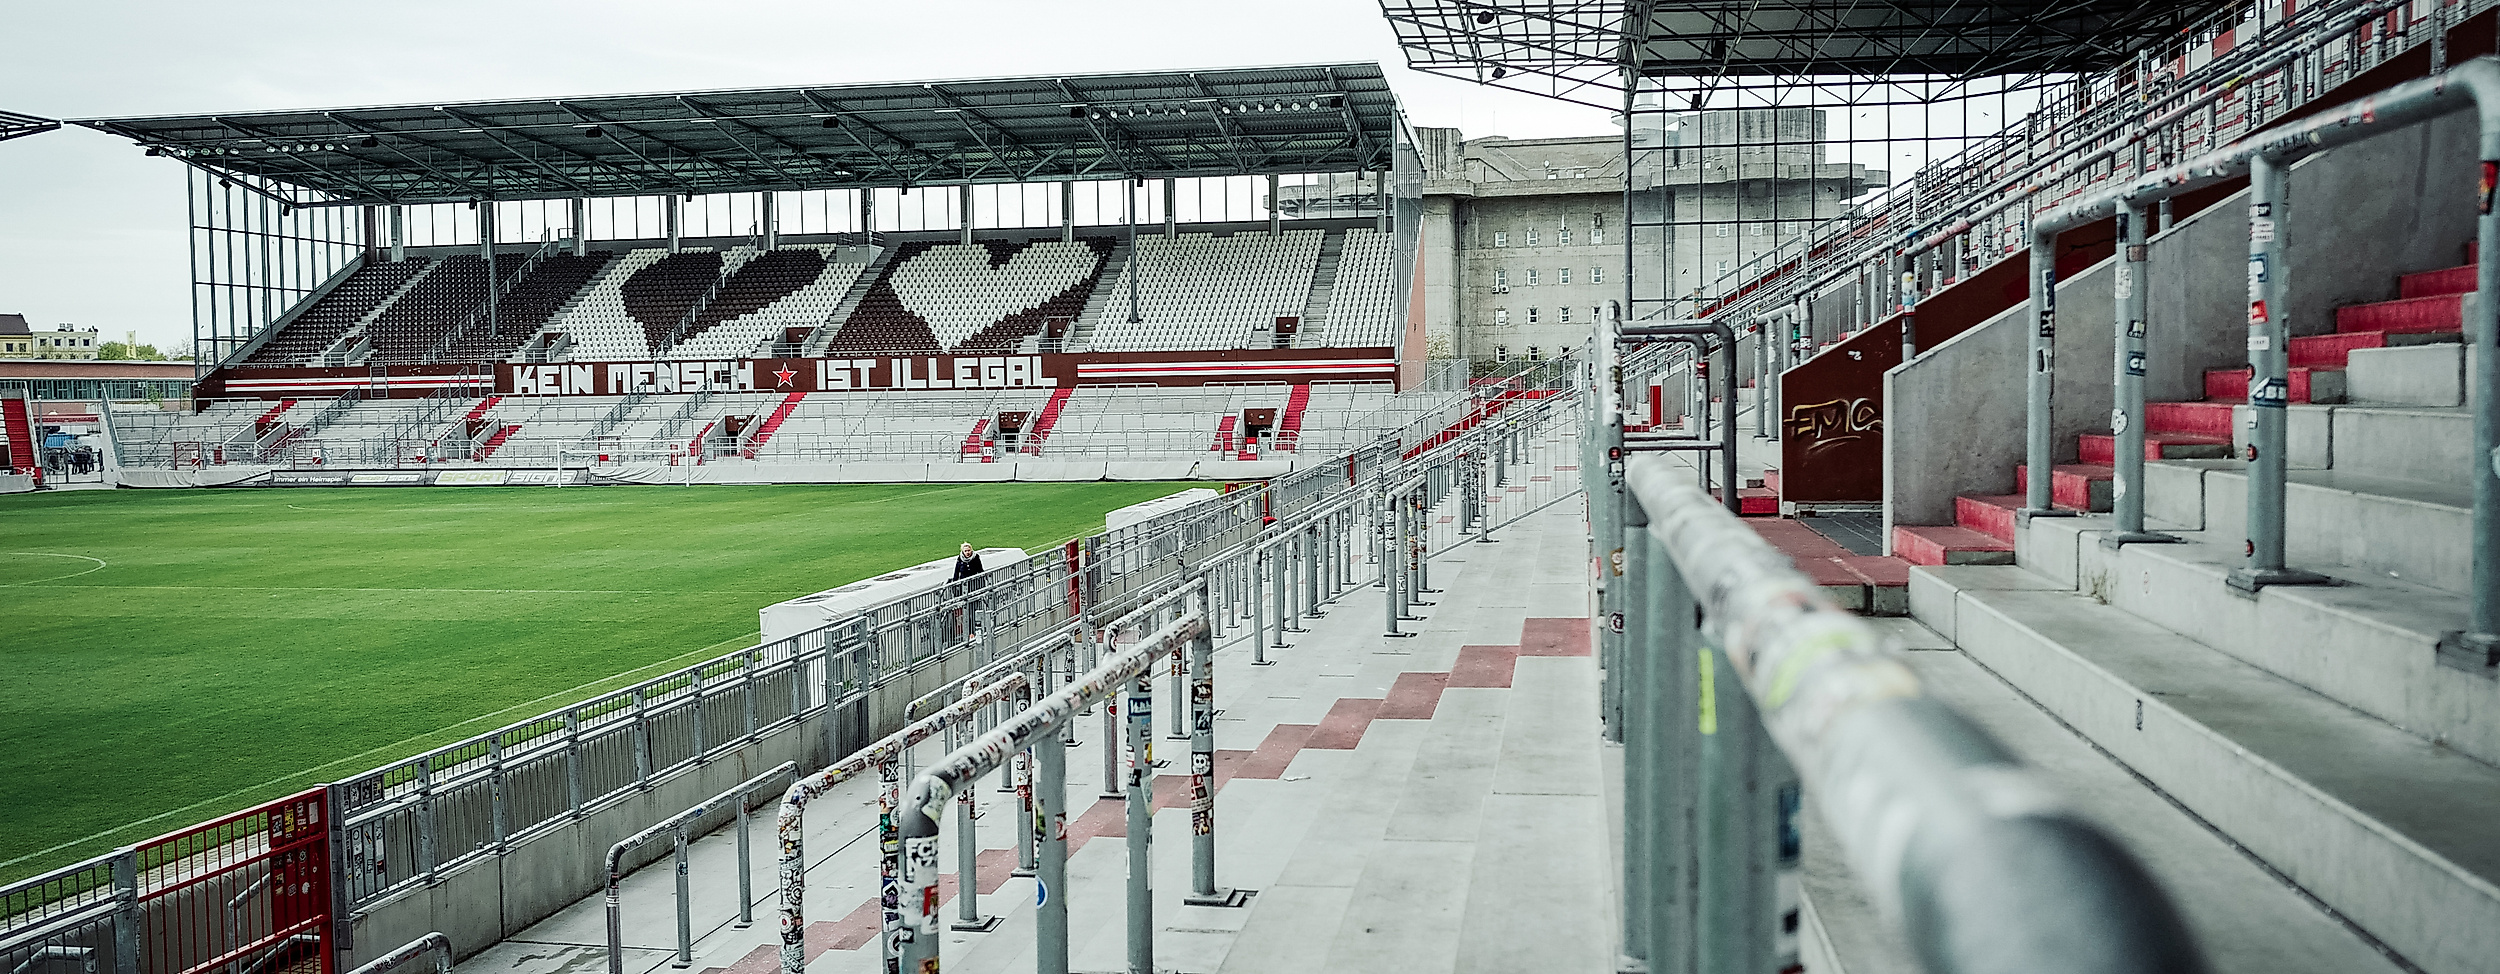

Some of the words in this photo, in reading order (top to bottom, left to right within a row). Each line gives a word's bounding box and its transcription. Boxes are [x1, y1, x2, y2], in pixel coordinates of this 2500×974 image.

[513, 364, 594, 394] KEIN
[607, 361, 754, 394] MENSCH
[816, 358, 877, 390] IST
[891, 355, 1058, 389] ILLEGAL
[438, 472, 506, 483] SPORT
